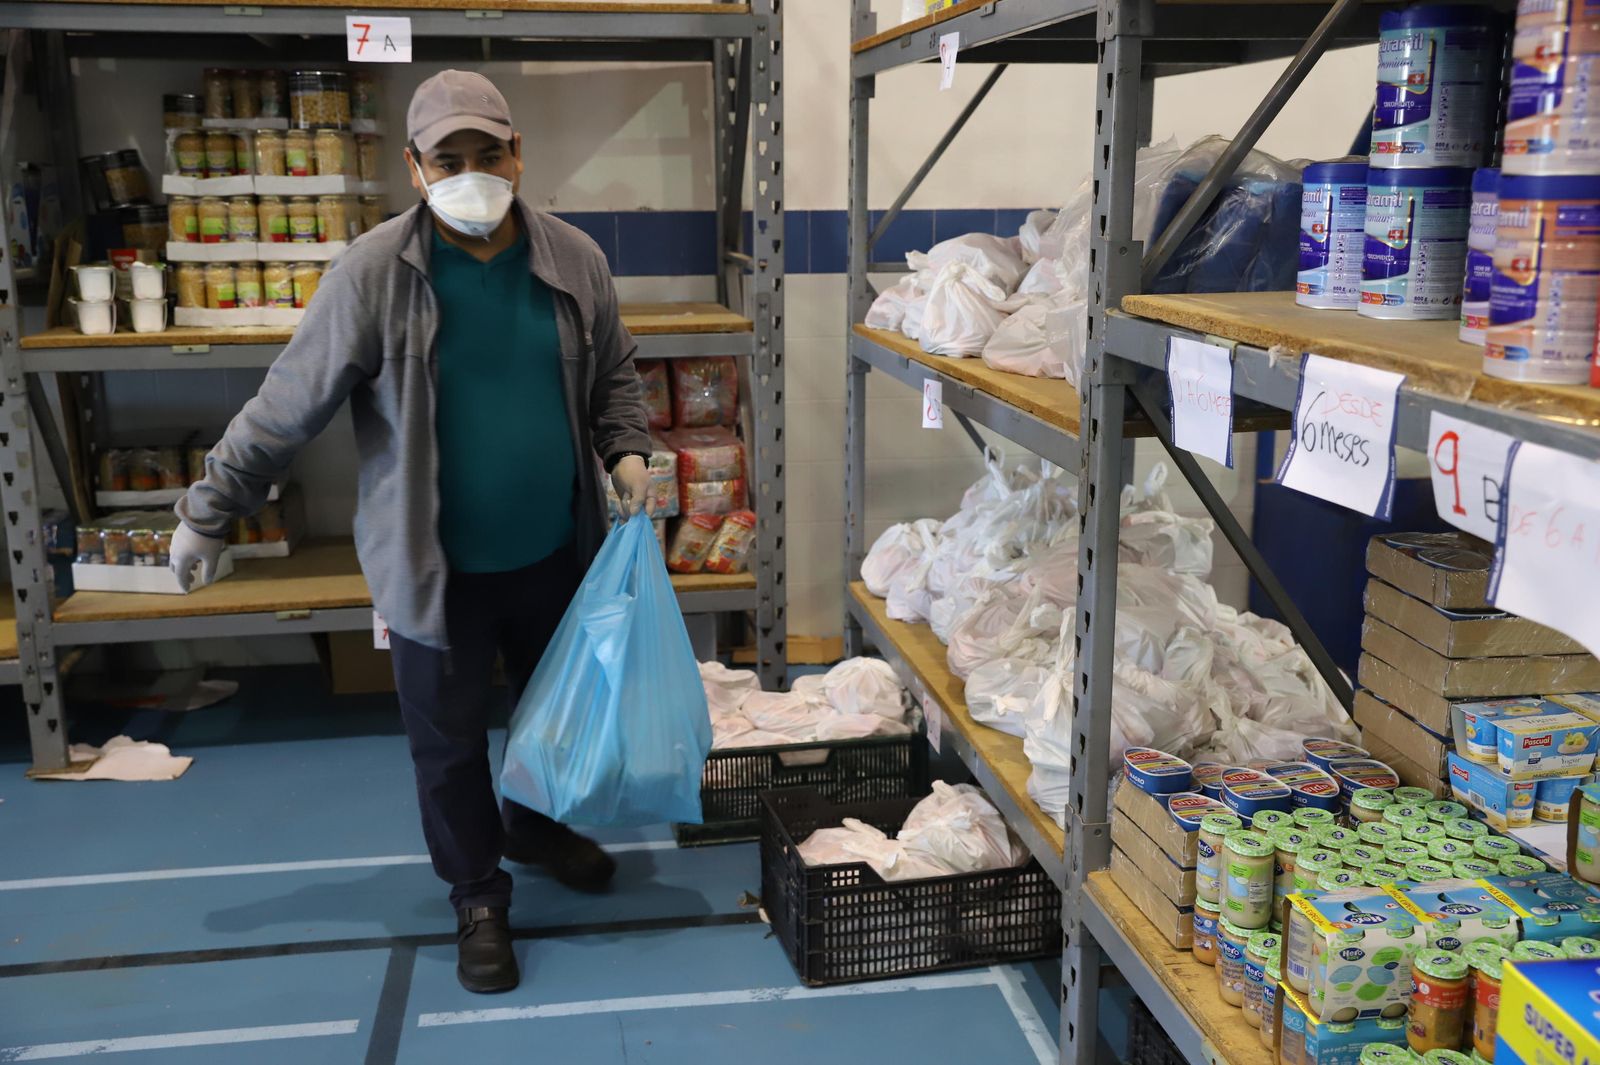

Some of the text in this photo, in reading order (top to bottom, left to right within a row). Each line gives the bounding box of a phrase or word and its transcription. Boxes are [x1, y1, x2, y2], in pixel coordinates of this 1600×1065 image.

[352, 23, 397, 55] 7 A
[1302, 189, 1323, 204] amil
[1301, 391, 1326, 452] 6
[1545, 506, 1564, 549] 6
[1524, 736, 1551, 748] Pascual
[1129, 773, 1145, 785] MAGRO
[1229, 773, 1257, 781] apis
[1446, 905, 1479, 915] Hero
[1350, 915, 1384, 924] Hero
[1438, 938, 1459, 947] Hero
[1223, 942, 1240, 956] Hero
[1342, 949, 1364, 957] Hero
[1245, 963, 1264, 978] Hero
